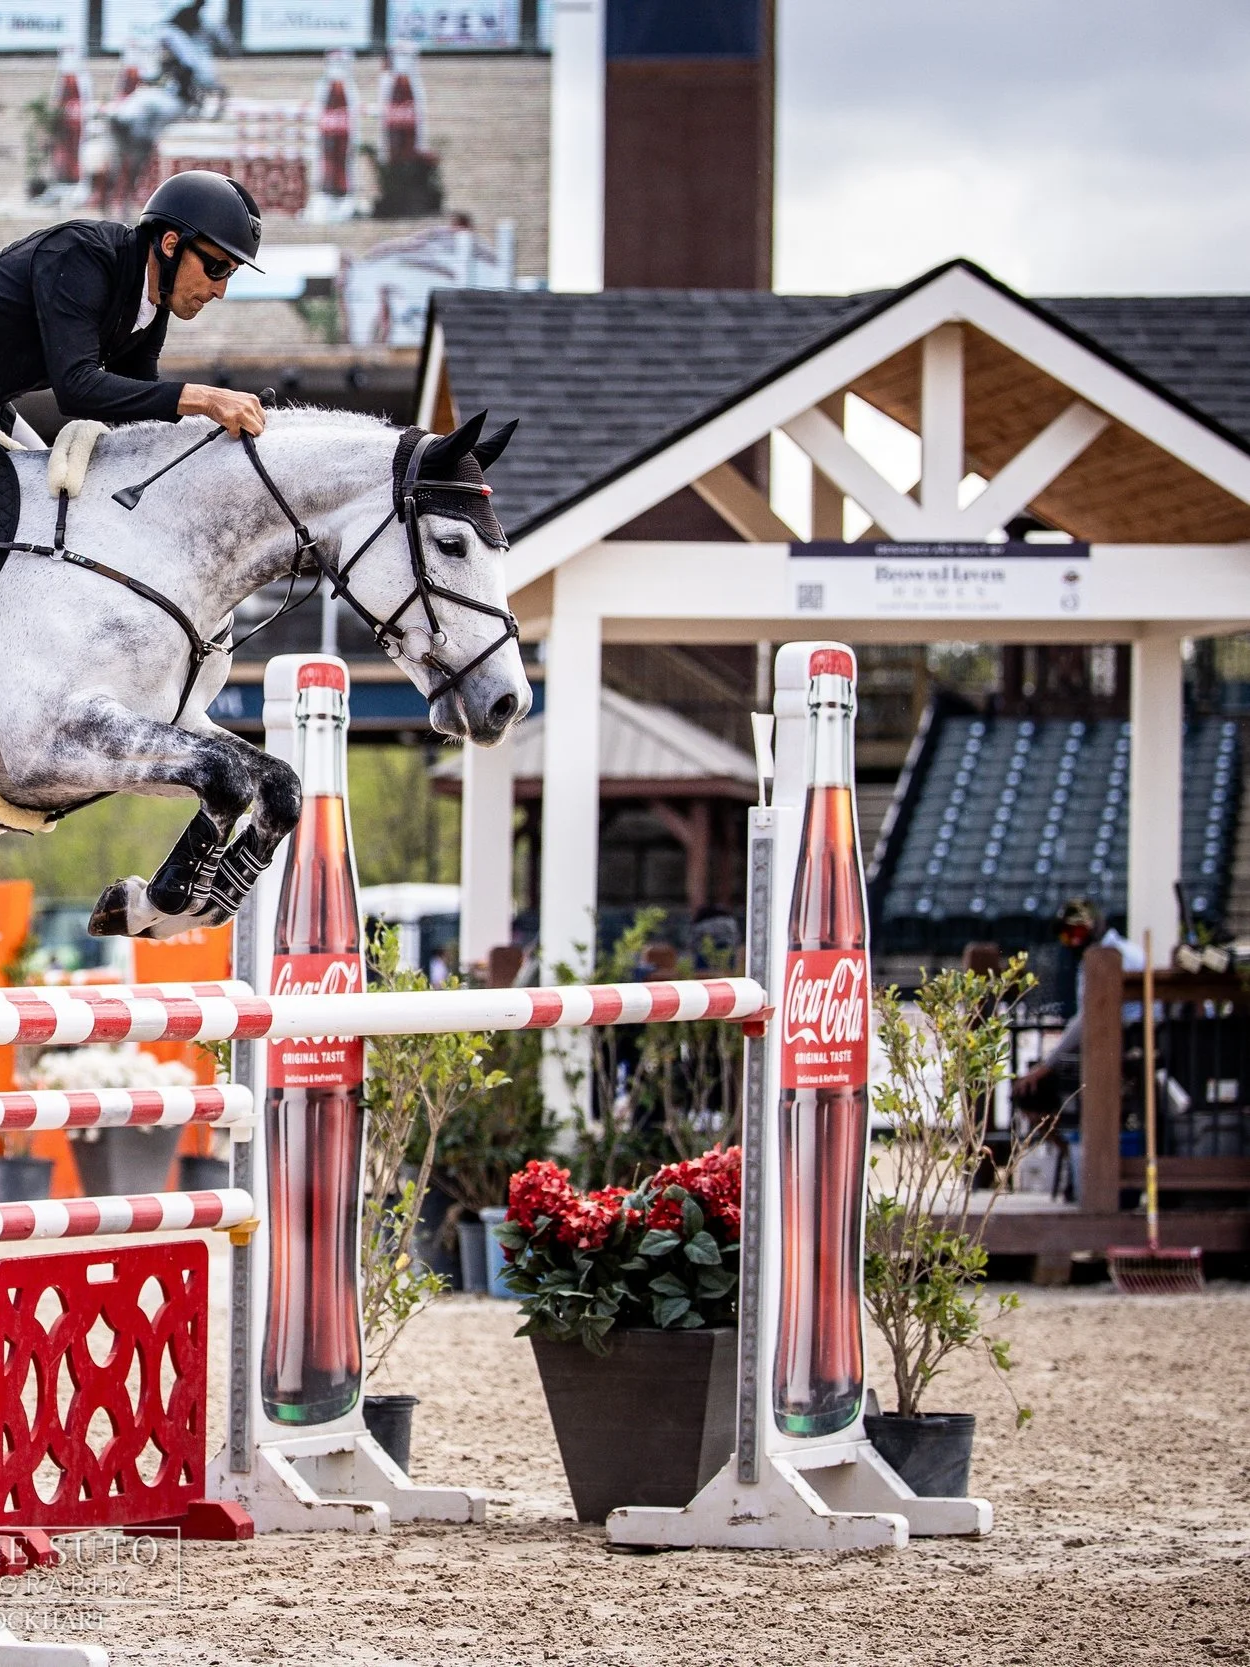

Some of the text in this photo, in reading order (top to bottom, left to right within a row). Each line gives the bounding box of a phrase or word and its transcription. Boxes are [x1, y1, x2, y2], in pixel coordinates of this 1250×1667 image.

[784, 957, 864, 1046] Coca-Cola
[282, 1051, 346, 1065] ORIGINAL TASTE
[795, 1050, 852, 1064] ORIGINAL TASTE
[315, 1073, 342, 1083] Refreshing
